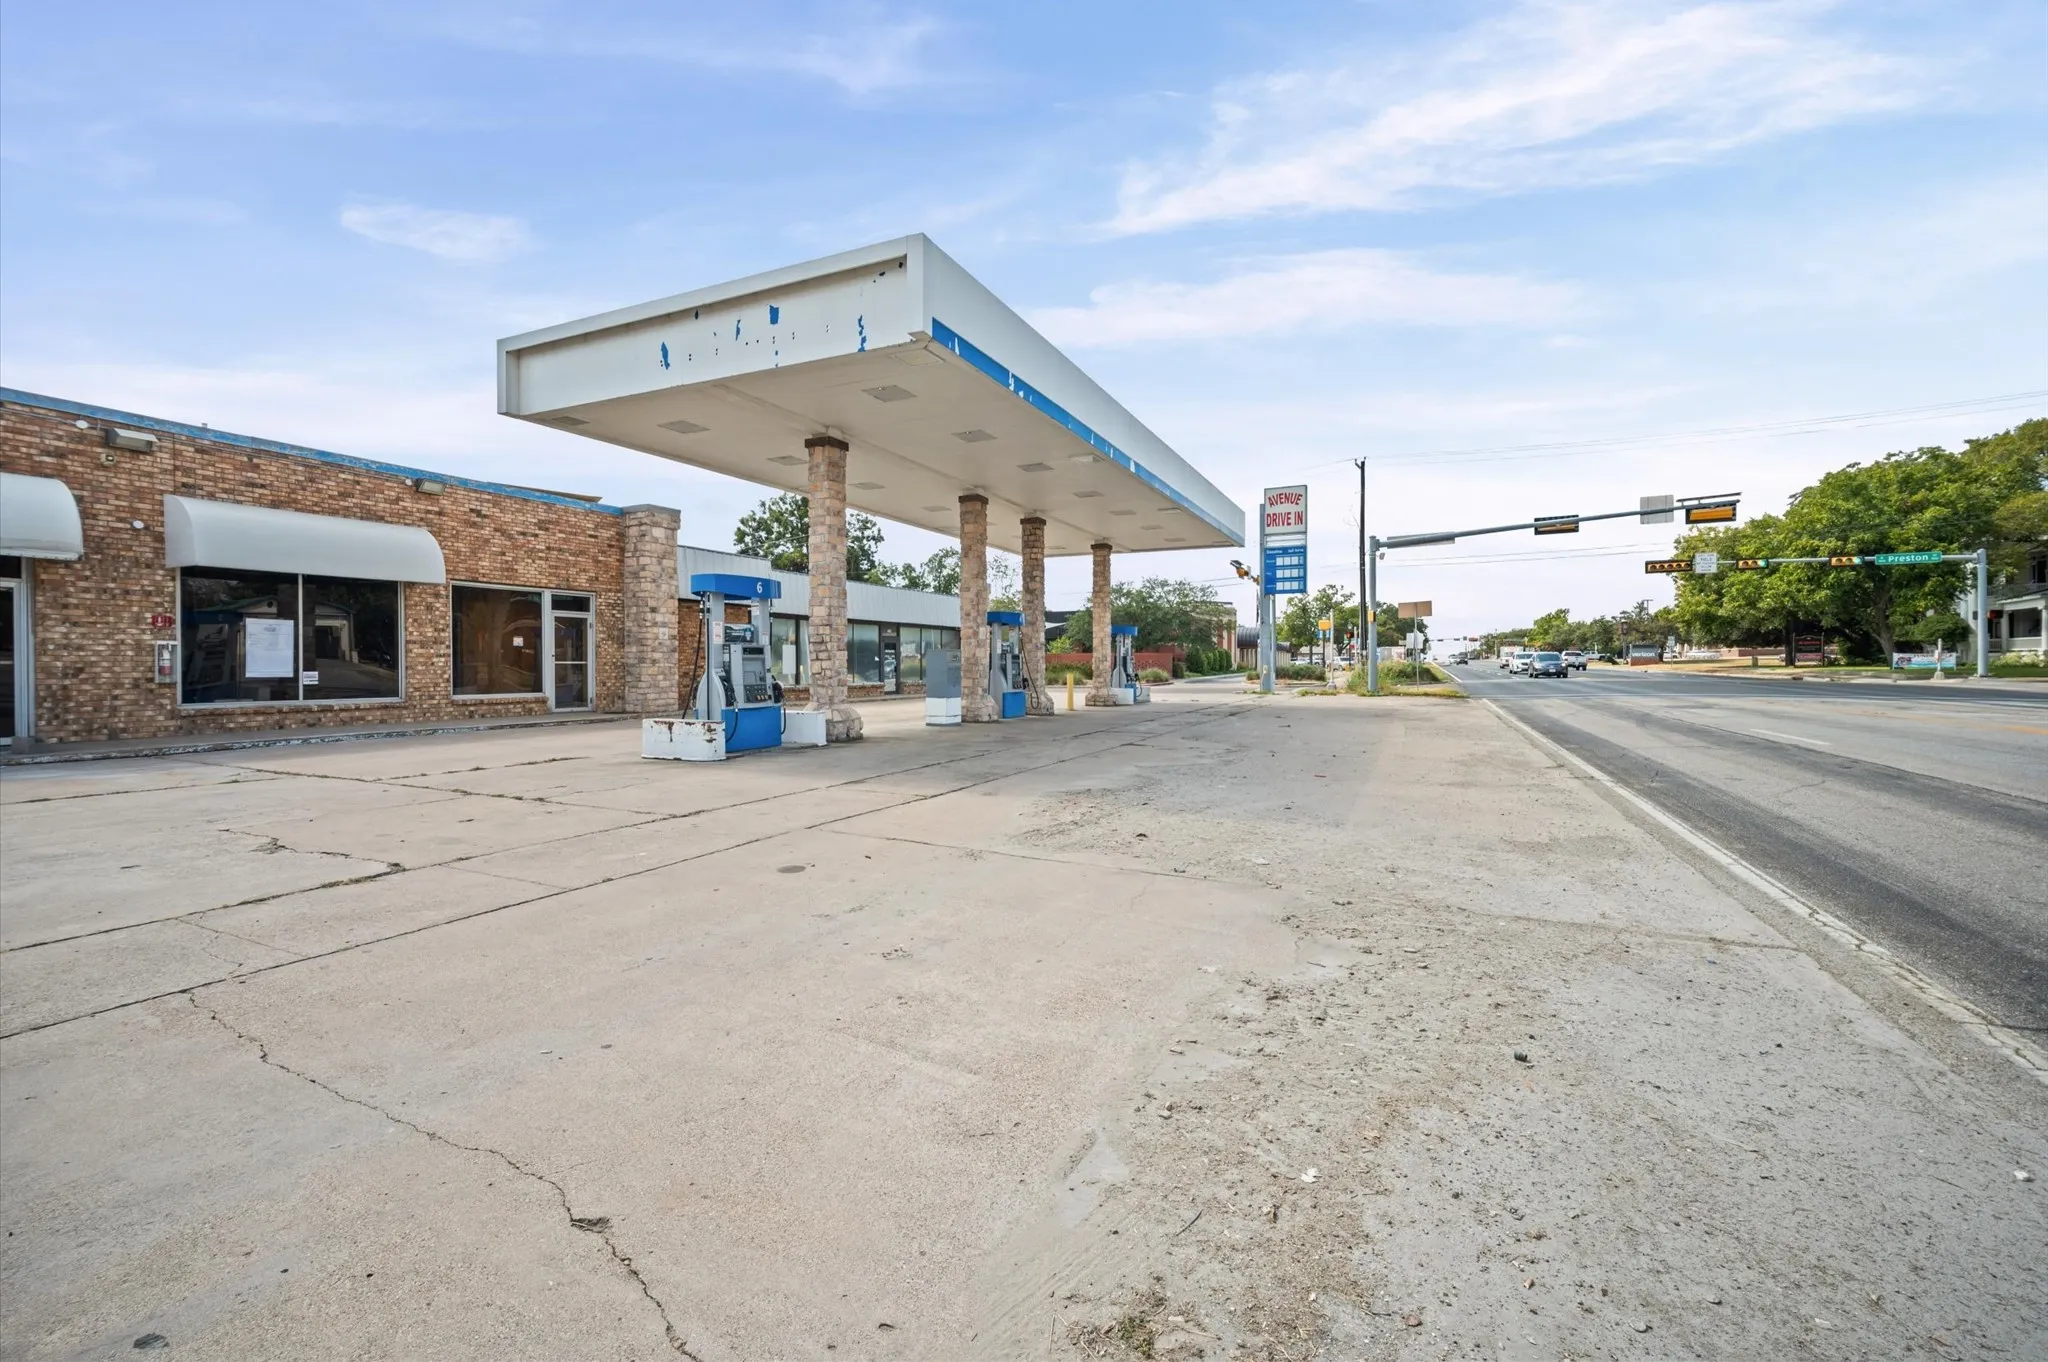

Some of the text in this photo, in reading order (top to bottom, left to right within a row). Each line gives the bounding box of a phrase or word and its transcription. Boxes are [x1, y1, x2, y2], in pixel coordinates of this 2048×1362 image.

[1267, 492, 1303, 507] AVENUE
[1266, 511, 1303, 527] DRIVE IN
[1888, 554, 1929, 562] Preston
[756, 581, 763, 594] 6
